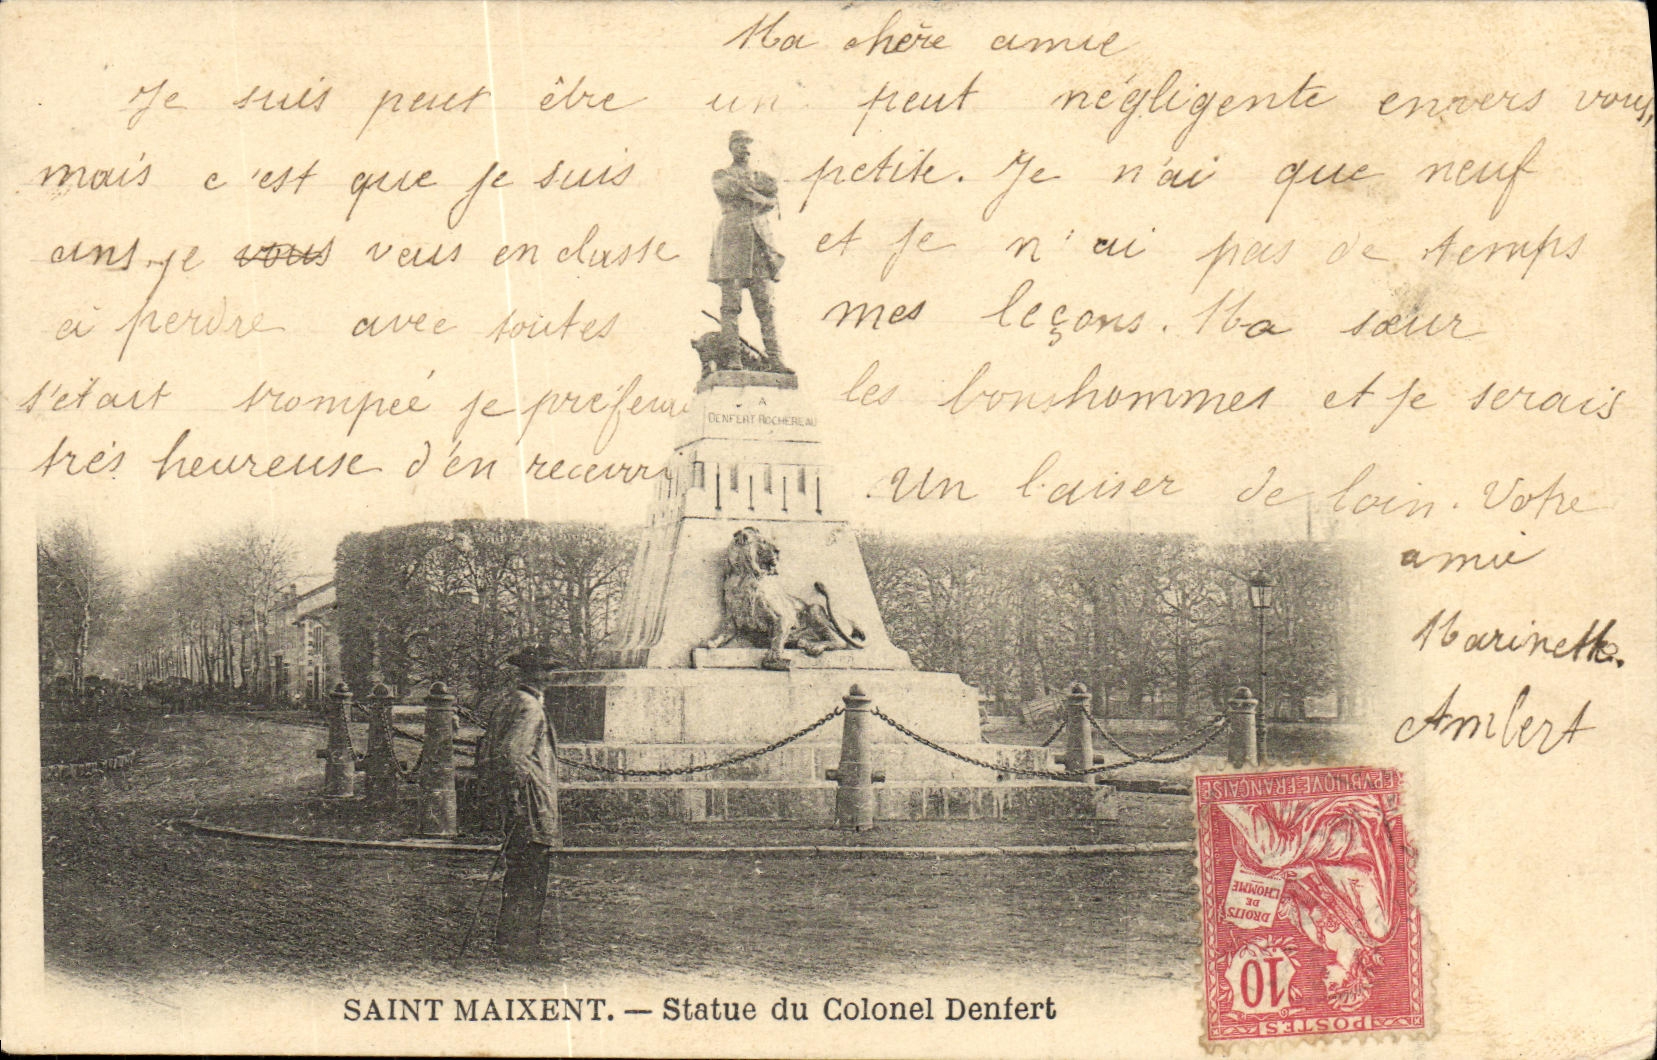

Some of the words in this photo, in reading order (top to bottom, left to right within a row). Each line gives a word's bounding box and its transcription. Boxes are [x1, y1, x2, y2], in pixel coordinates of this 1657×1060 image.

[990, 30, 1131, 57] amie
[126, 79, 188, 130] Je
[234, 76, 333, 112] suis
[356, 85, 492, 140] peut
[539, 75, 649, 112] être
[704, 90, 779, 114] un
[854, 72, 984, 136] peut
[1051, 69, 1338, 152] négligente
[1378, 88, 1547, 118] envers
[40, 152, 153, 190] mais
[346, 169, 438, 222] que
[447, 161, 514, 229] je
[536, 147, 637, 188] suis
[983, 149, 1061, 221] Je
[1112, 156, 1220, 189] n'ai
[1265, 159, 1385, 223] que
[1416, 136, 1547, 222] neuf
[493, 240, 540, 267] en
[556, 223, 680, 268] classe
[816, 219, 866, 256] et
[880, 218, 956, 282] je
[1192, 231, 1296, 294] pas
[1326, 231, 1389, 266] de
[1421, 224, 1589, 280] temps
[115, 296, 285, 362] perdre
[352, 312, 458, 337] avec
[485, 299, 622, 344] toutes
[822, 300, 927, 331] mes
[452, 390, 517, 443] je
[841, 360, 900, 406] les
[1324, 371, 1385, 410] et
[1369, 377, 1438, 434] je
[1467, 381, 1627, 420] serais
[152, 428, 382, 480] heureuse
[1236, 466, 1314, 507] de
[1483, 473, 1608, 520] Votre
[1400, 530, 1547, 573] amie
[1227, 906, 1271, 923] DROITS
[1246, 898, 1260, 907] DE
[1240, 957, 1286, 1008] 10
[1266, 1017, 1366, 1035] POSTES
